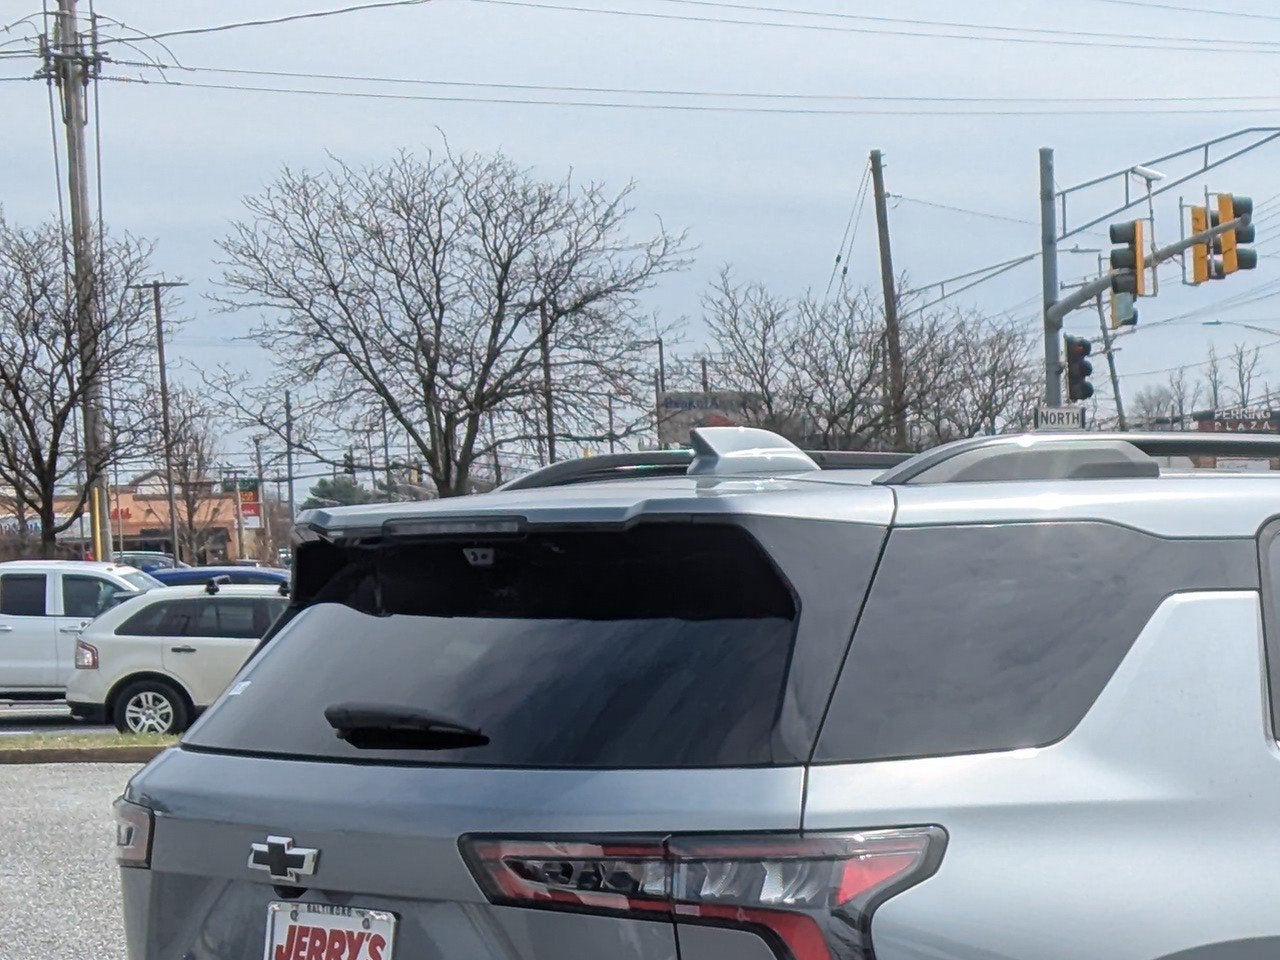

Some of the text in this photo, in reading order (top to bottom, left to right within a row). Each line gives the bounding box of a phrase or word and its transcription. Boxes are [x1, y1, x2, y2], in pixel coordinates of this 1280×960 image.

[1040, 411, 1080, 426] NORTH
[1214, 410, 1271, 420] PERRING
[1214, 421, 1271, 431] PLAZA
